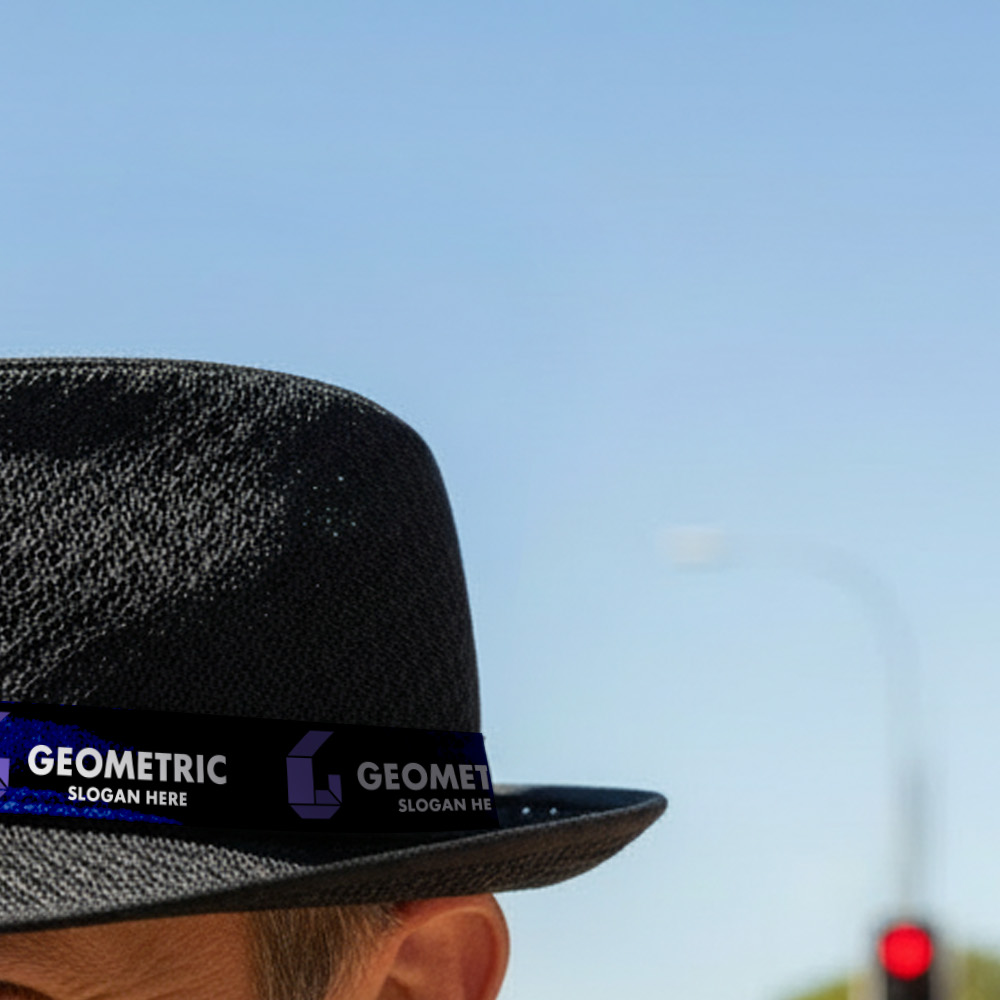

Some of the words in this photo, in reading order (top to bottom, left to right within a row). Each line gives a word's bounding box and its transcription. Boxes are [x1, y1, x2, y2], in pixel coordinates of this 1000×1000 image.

[27, 744, 228, 785] GEOMETRIC
[67, 785, 140, 804] SLOGAN
[145, 790, 188, 807] HERE
[398, 798, 467, 812] SLOGAN
